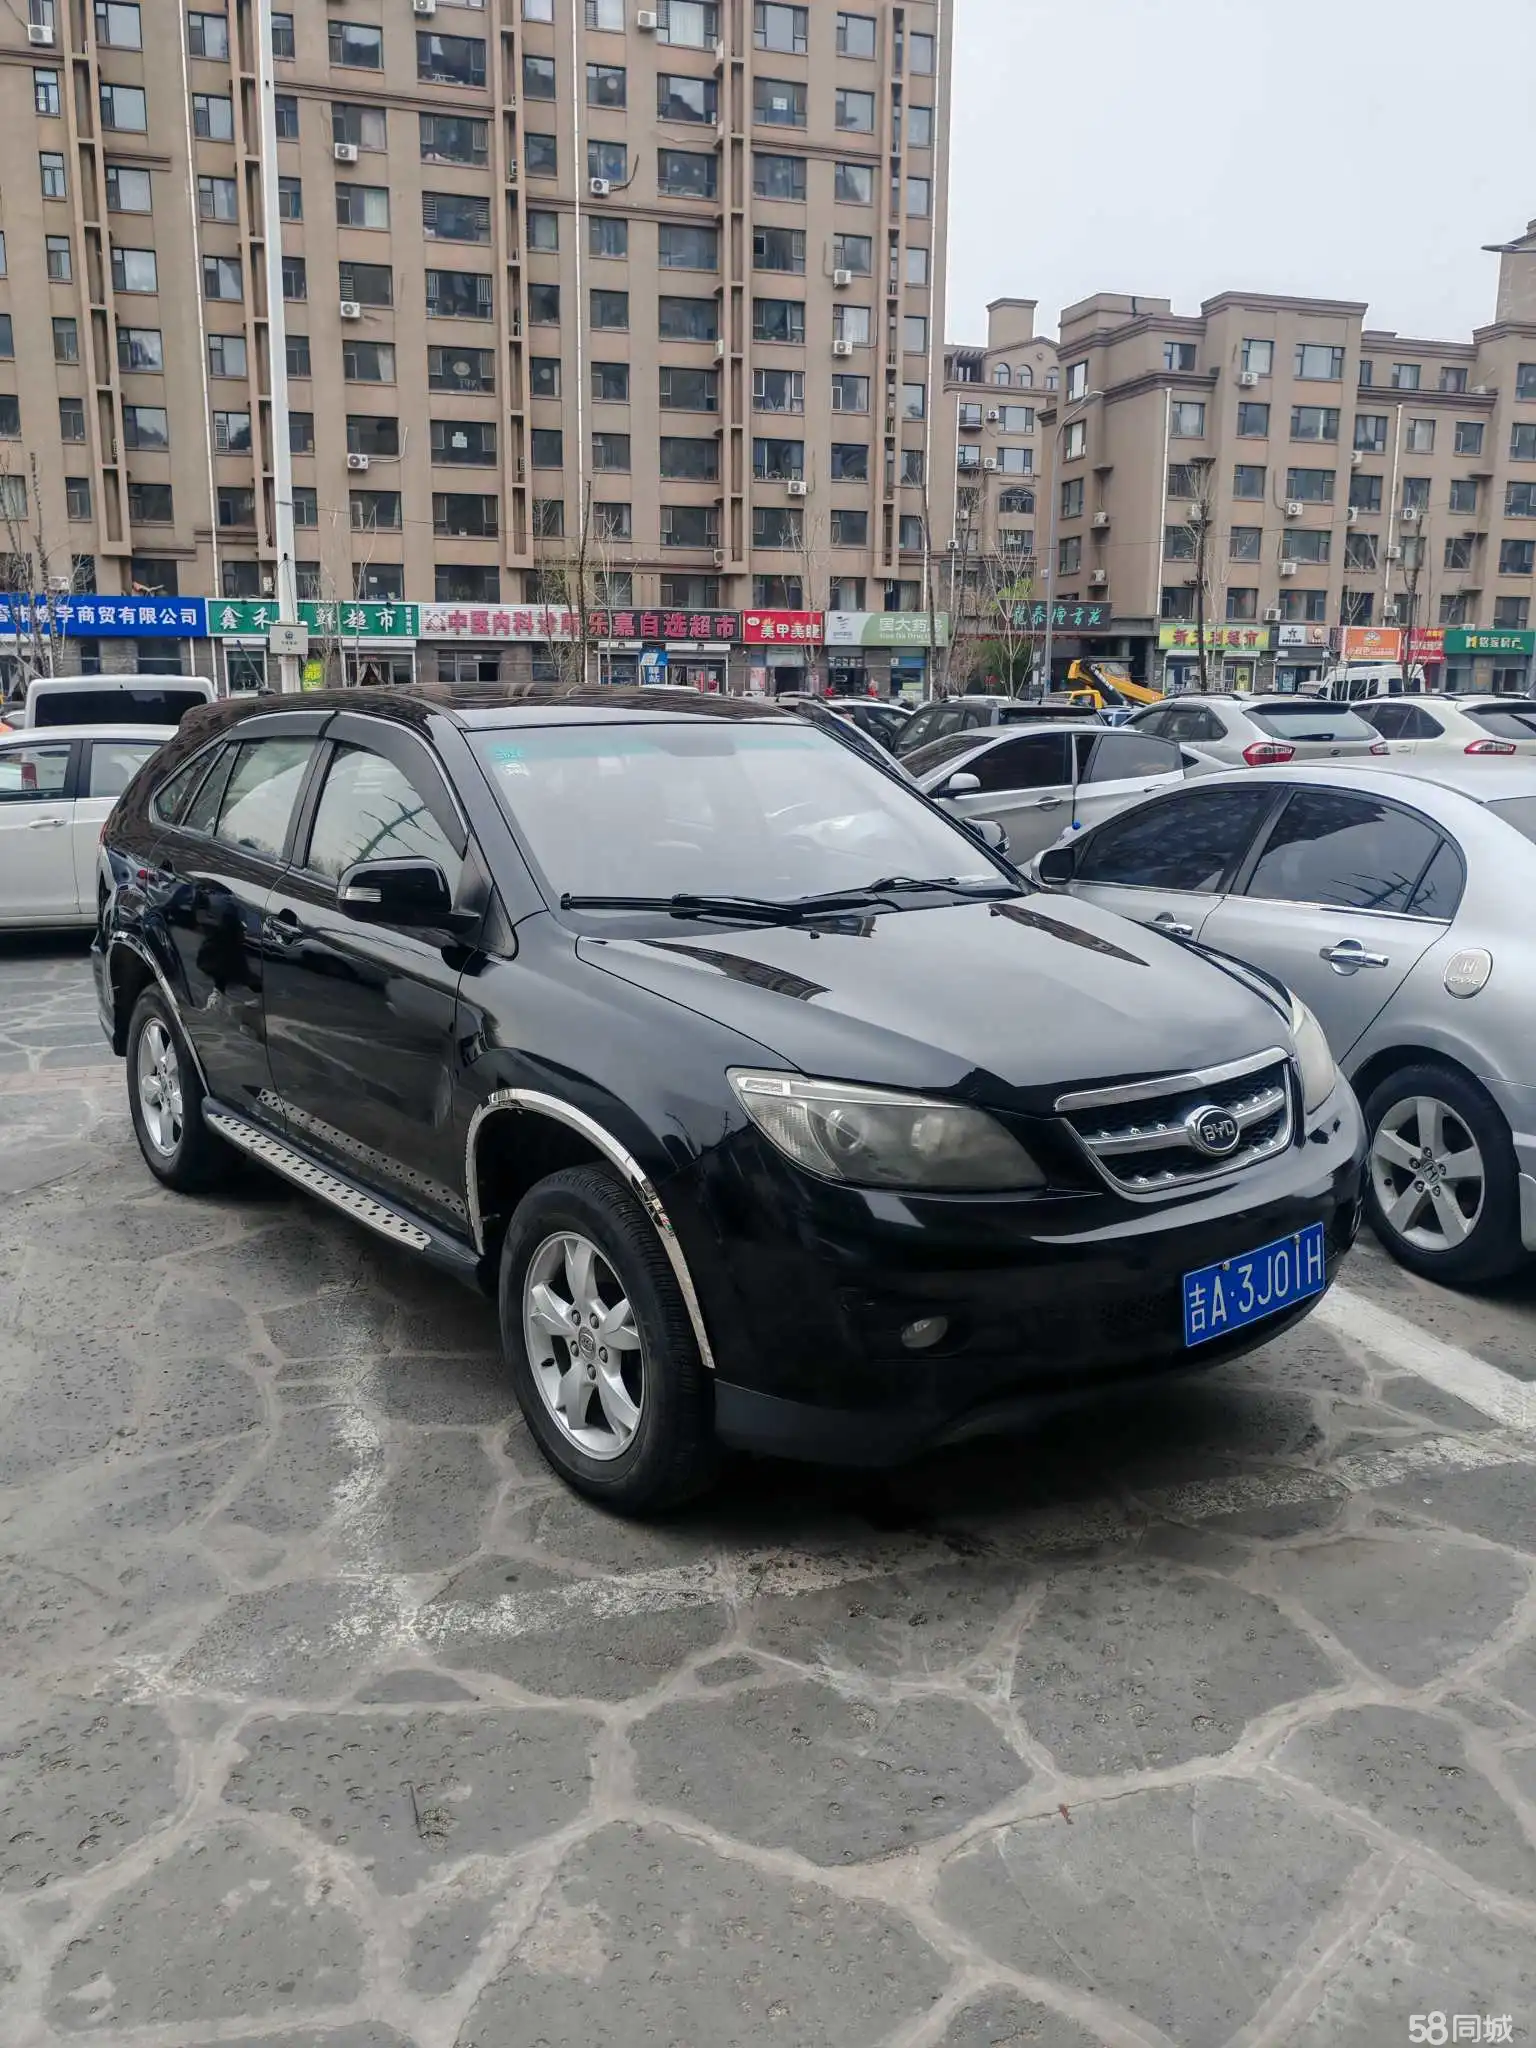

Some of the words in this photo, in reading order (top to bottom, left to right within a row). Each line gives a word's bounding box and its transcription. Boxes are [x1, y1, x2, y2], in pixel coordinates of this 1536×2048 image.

[219, 604, 397, 633] 鑫禾鲜超市
[1202, 1120, 1235, 1141] BYD
